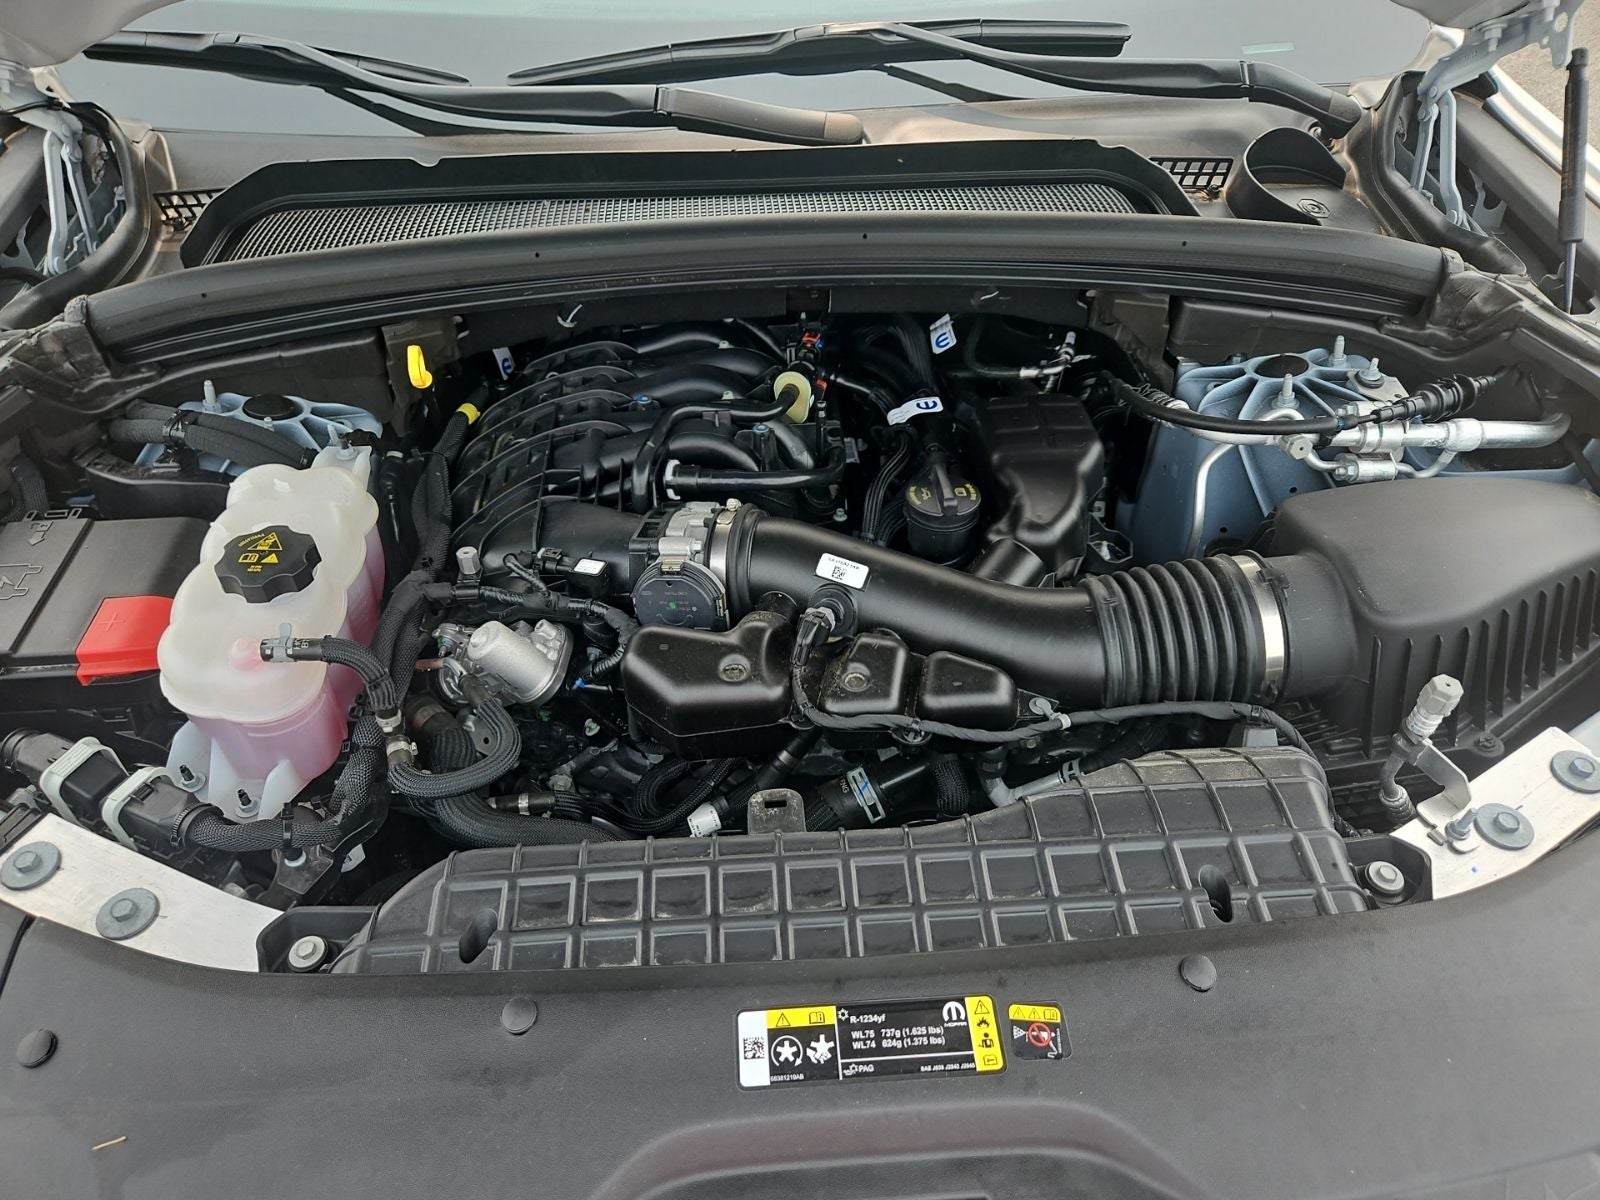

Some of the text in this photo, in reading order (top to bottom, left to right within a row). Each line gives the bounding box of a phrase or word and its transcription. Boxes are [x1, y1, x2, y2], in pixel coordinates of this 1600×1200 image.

[850, 1014, 886, 1024] R-1234yf
[851, 1025, 944, 1039] WL75 737g (1.625 lbs)
[852, 1035, 946, 1049] WL74 624g (1.375 lbs)
[858, 1064, 874, 1073] PAG
